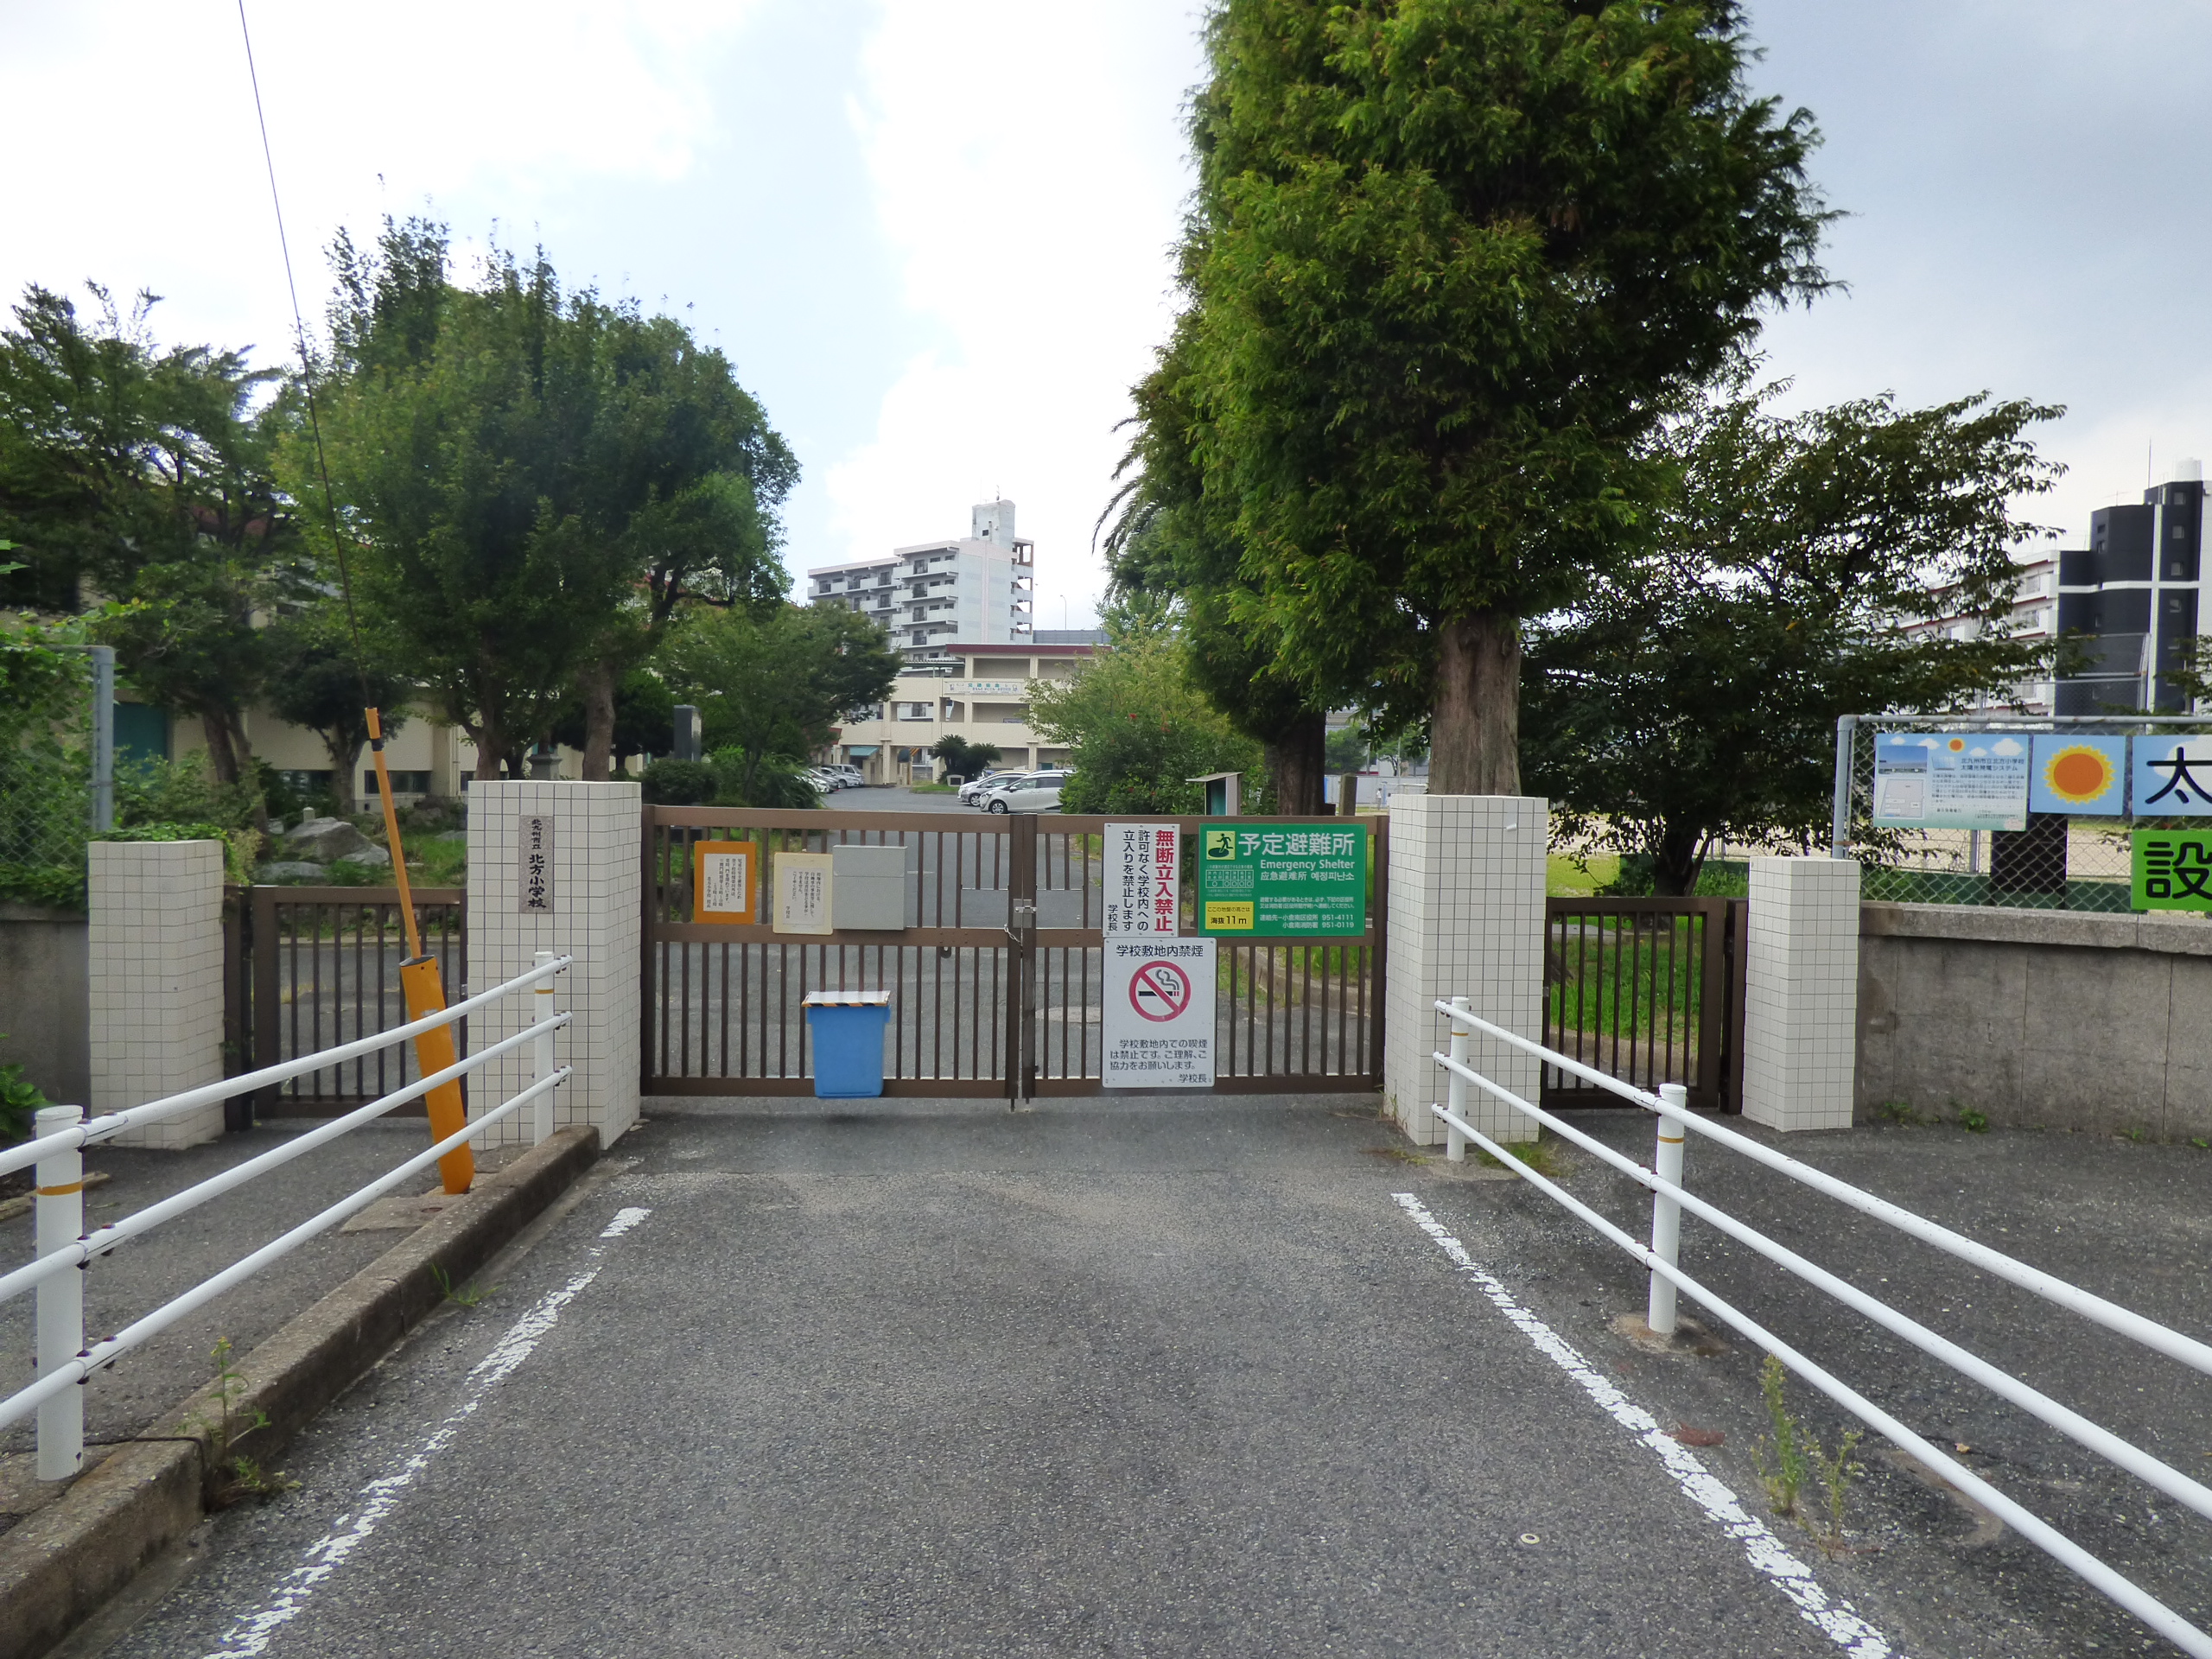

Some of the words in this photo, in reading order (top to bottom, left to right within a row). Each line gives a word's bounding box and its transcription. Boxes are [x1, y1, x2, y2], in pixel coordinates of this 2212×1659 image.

[2145, 747, 2212, 804] 太
[531, 818, 543, 849] 北九州市立
[1238, 833, 1355, 856] 予定避難所
[1122, 830, 1135, 931] 立入りを禁止します
[1137, 830, 1150, 931] 許可なく学校内への
[1154, 830, 1174, 931] 無断立入禁止
[1260, 860, 1316, 871] Emergency
[1319, 859, 1355, 869] Shelter
[2144, 842, 2212, 899] 設
[528, 854, 546, 909] 北方小学校
[1108, 904, 1118, 931] 学校長
[1116, 945, 1204, 957] 学校敷地内禁煙
[1109, 1061, 1196, 1071] 協力をお願いします。
[1179, 1073, 1207, 1083] 学校長
